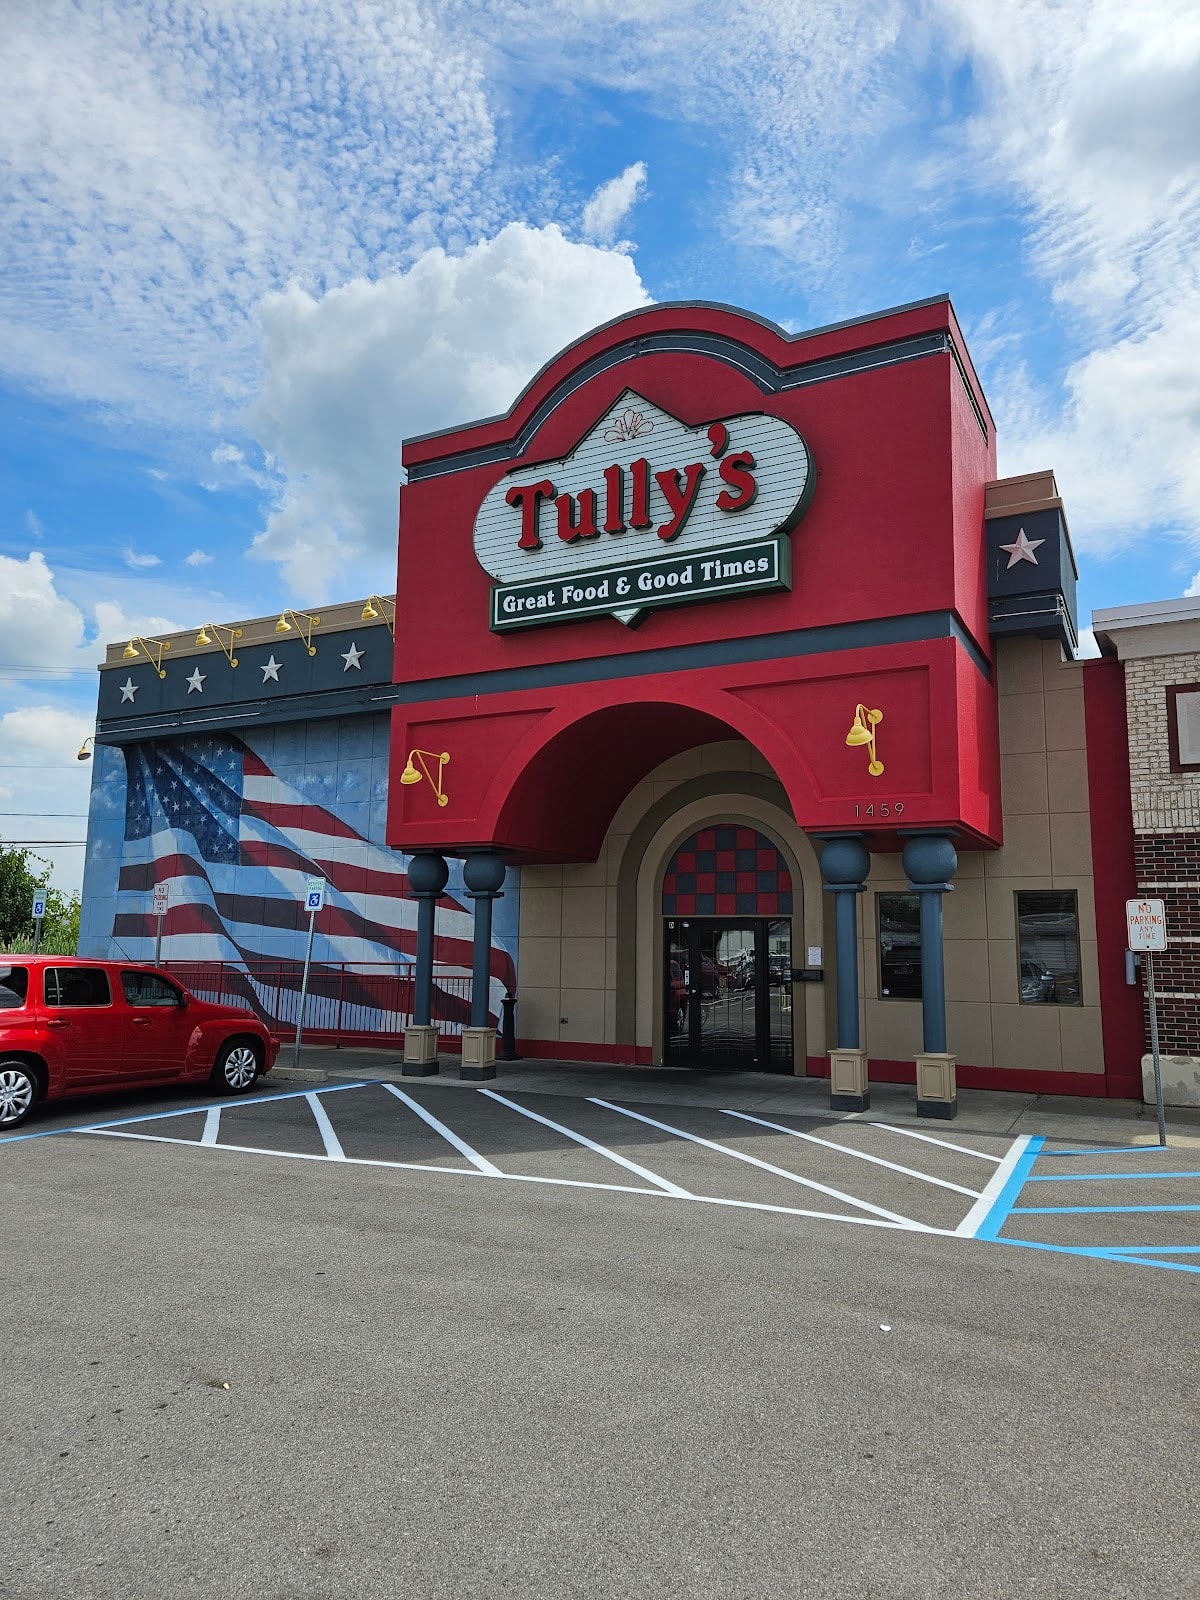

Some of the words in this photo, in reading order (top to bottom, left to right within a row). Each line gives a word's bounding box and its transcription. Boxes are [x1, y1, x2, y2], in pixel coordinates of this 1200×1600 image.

[505, 422, 758, 551] Tully's
[502, 589, 556, 613] Great
[561, 579, 609, 605] Food
[615, 576, 632, 595] &
[637, 565, 693, 591] Good
[700, 557, 769, 581] Times
[855, 802, 904, 817] 1459
[1138, 905, 1151, 913] NO
[1130, 915, 1162, 925] PARKING
